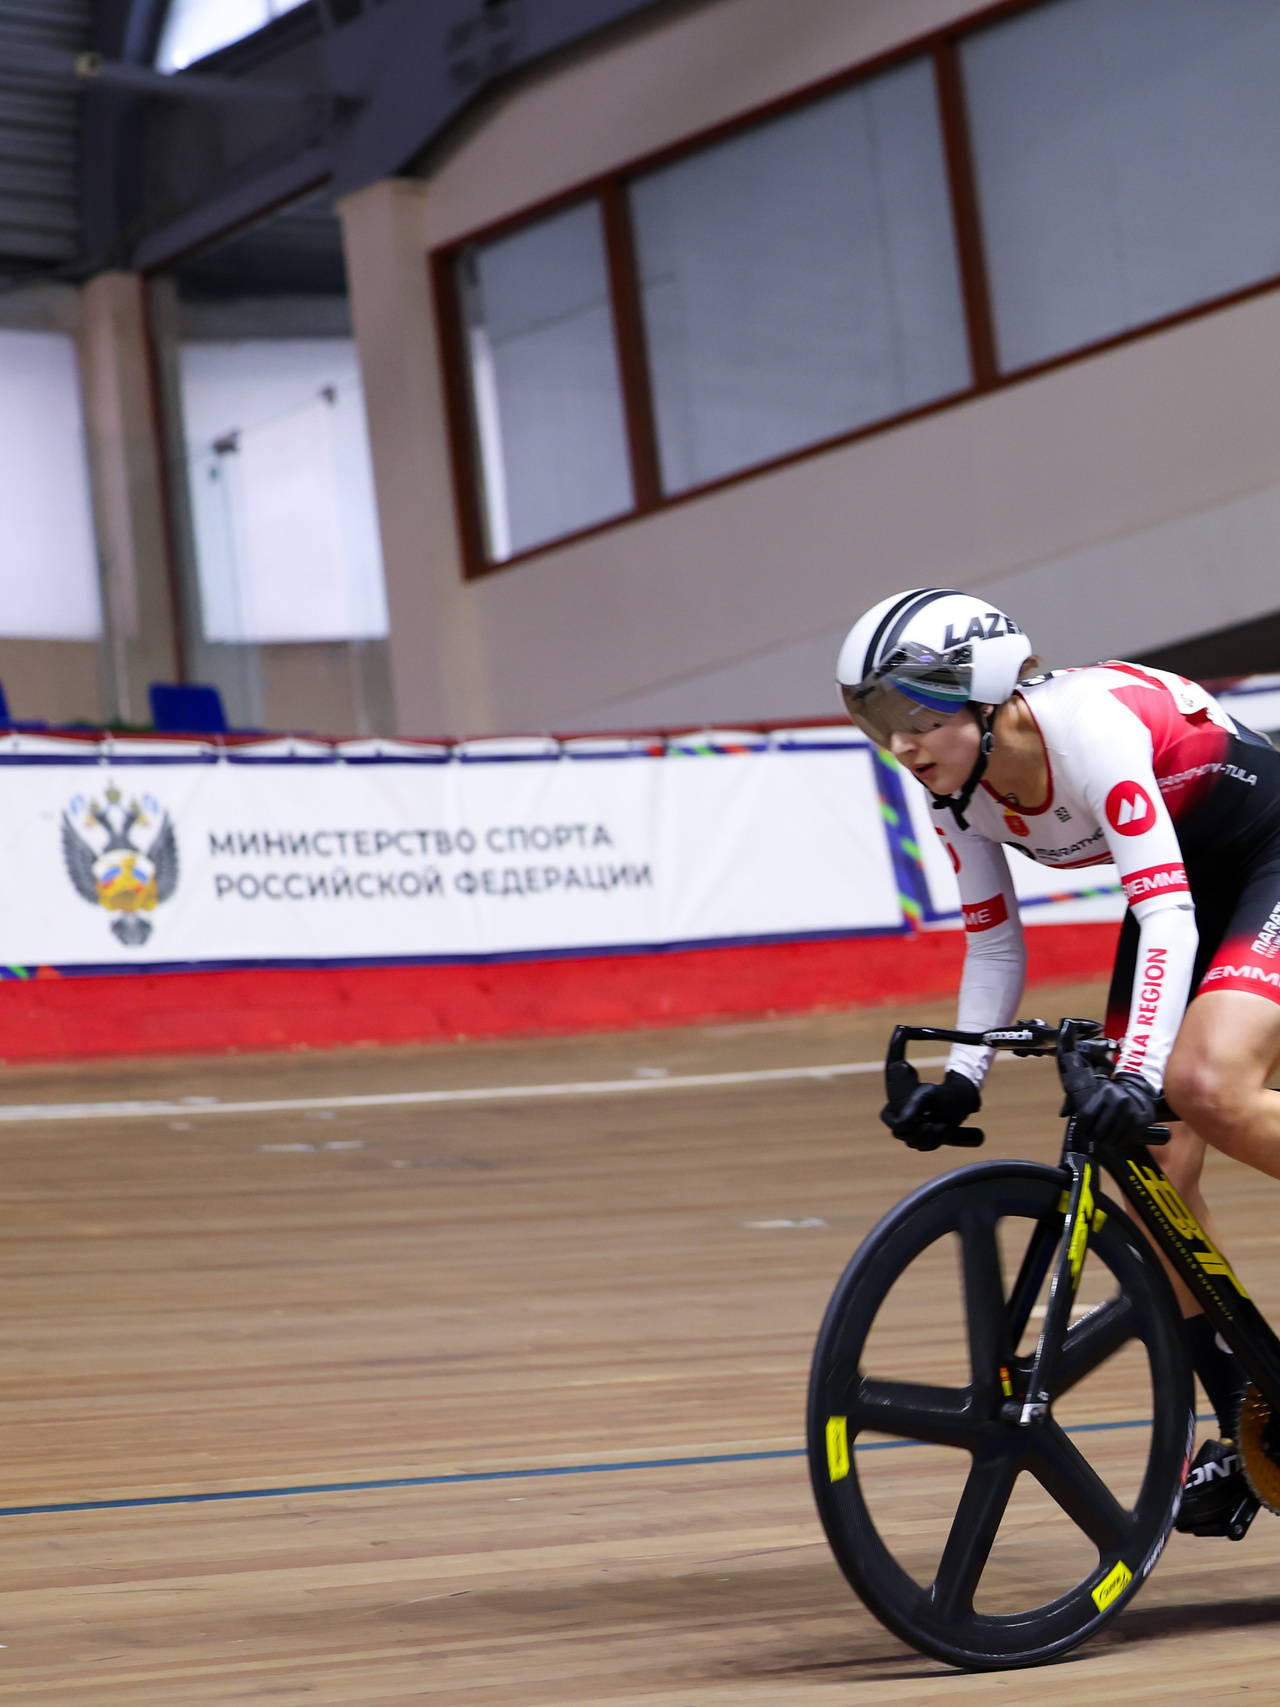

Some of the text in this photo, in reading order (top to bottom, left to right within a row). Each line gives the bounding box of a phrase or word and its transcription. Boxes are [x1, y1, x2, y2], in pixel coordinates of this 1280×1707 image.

[208, 823, 613, 858] МИНИСТЕРСТВО СПОРТА
[214, 863, 653, 900] РОССИЙСКОЙ ФЕДЕРАЦИИ
[1136, 948, 1168, 1027] REGION
